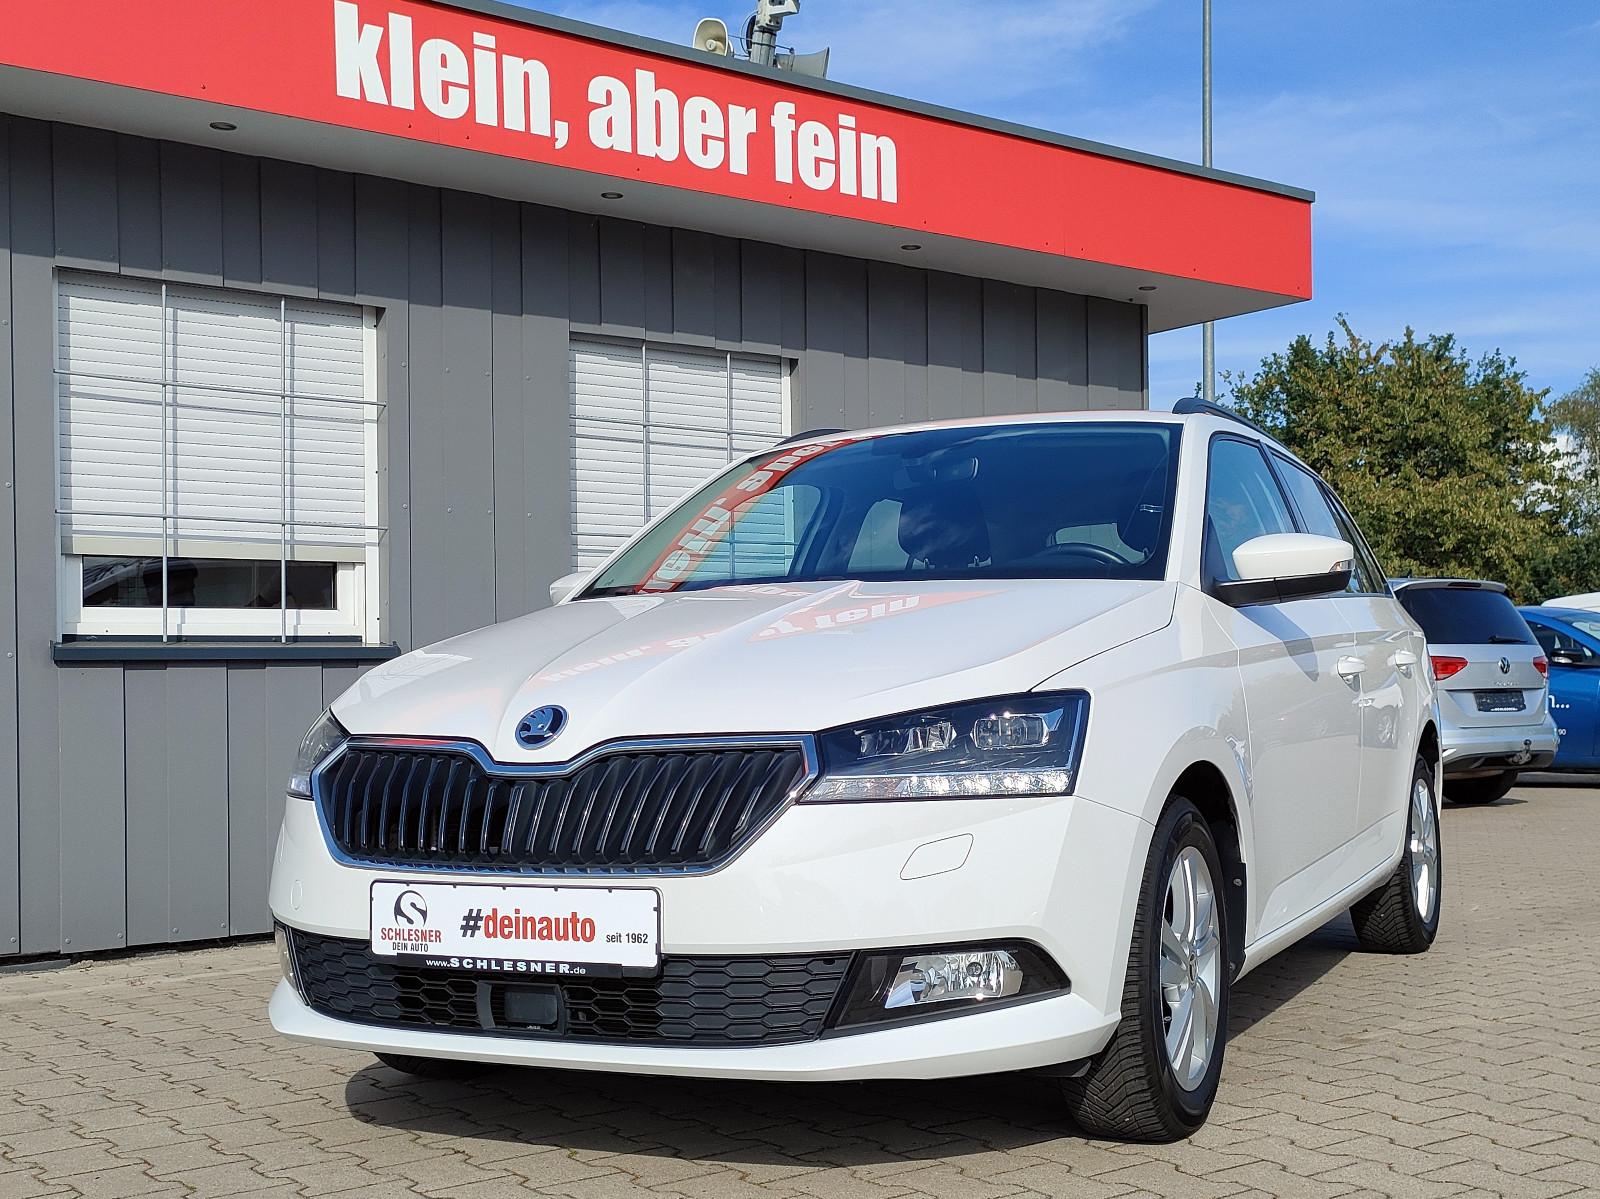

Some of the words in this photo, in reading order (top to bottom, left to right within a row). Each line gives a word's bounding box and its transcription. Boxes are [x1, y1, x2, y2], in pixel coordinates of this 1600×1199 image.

[334, 0, 569, 149] klein,
[587, 68, 757, 176] aber
[771, 101, 898, 203] fein
[381, 927, 442, 943] SCHLESNER
[460, 908, 596, 943] #deinauto
[606, 932, 622, 944] seit
[625, 932, 649, 945] 1962
[392, 942, 409, 952] DEIN
[410, 943, 429, 953] AUTO
[425, 957, 586, 975] www.SCHLESNER.de
